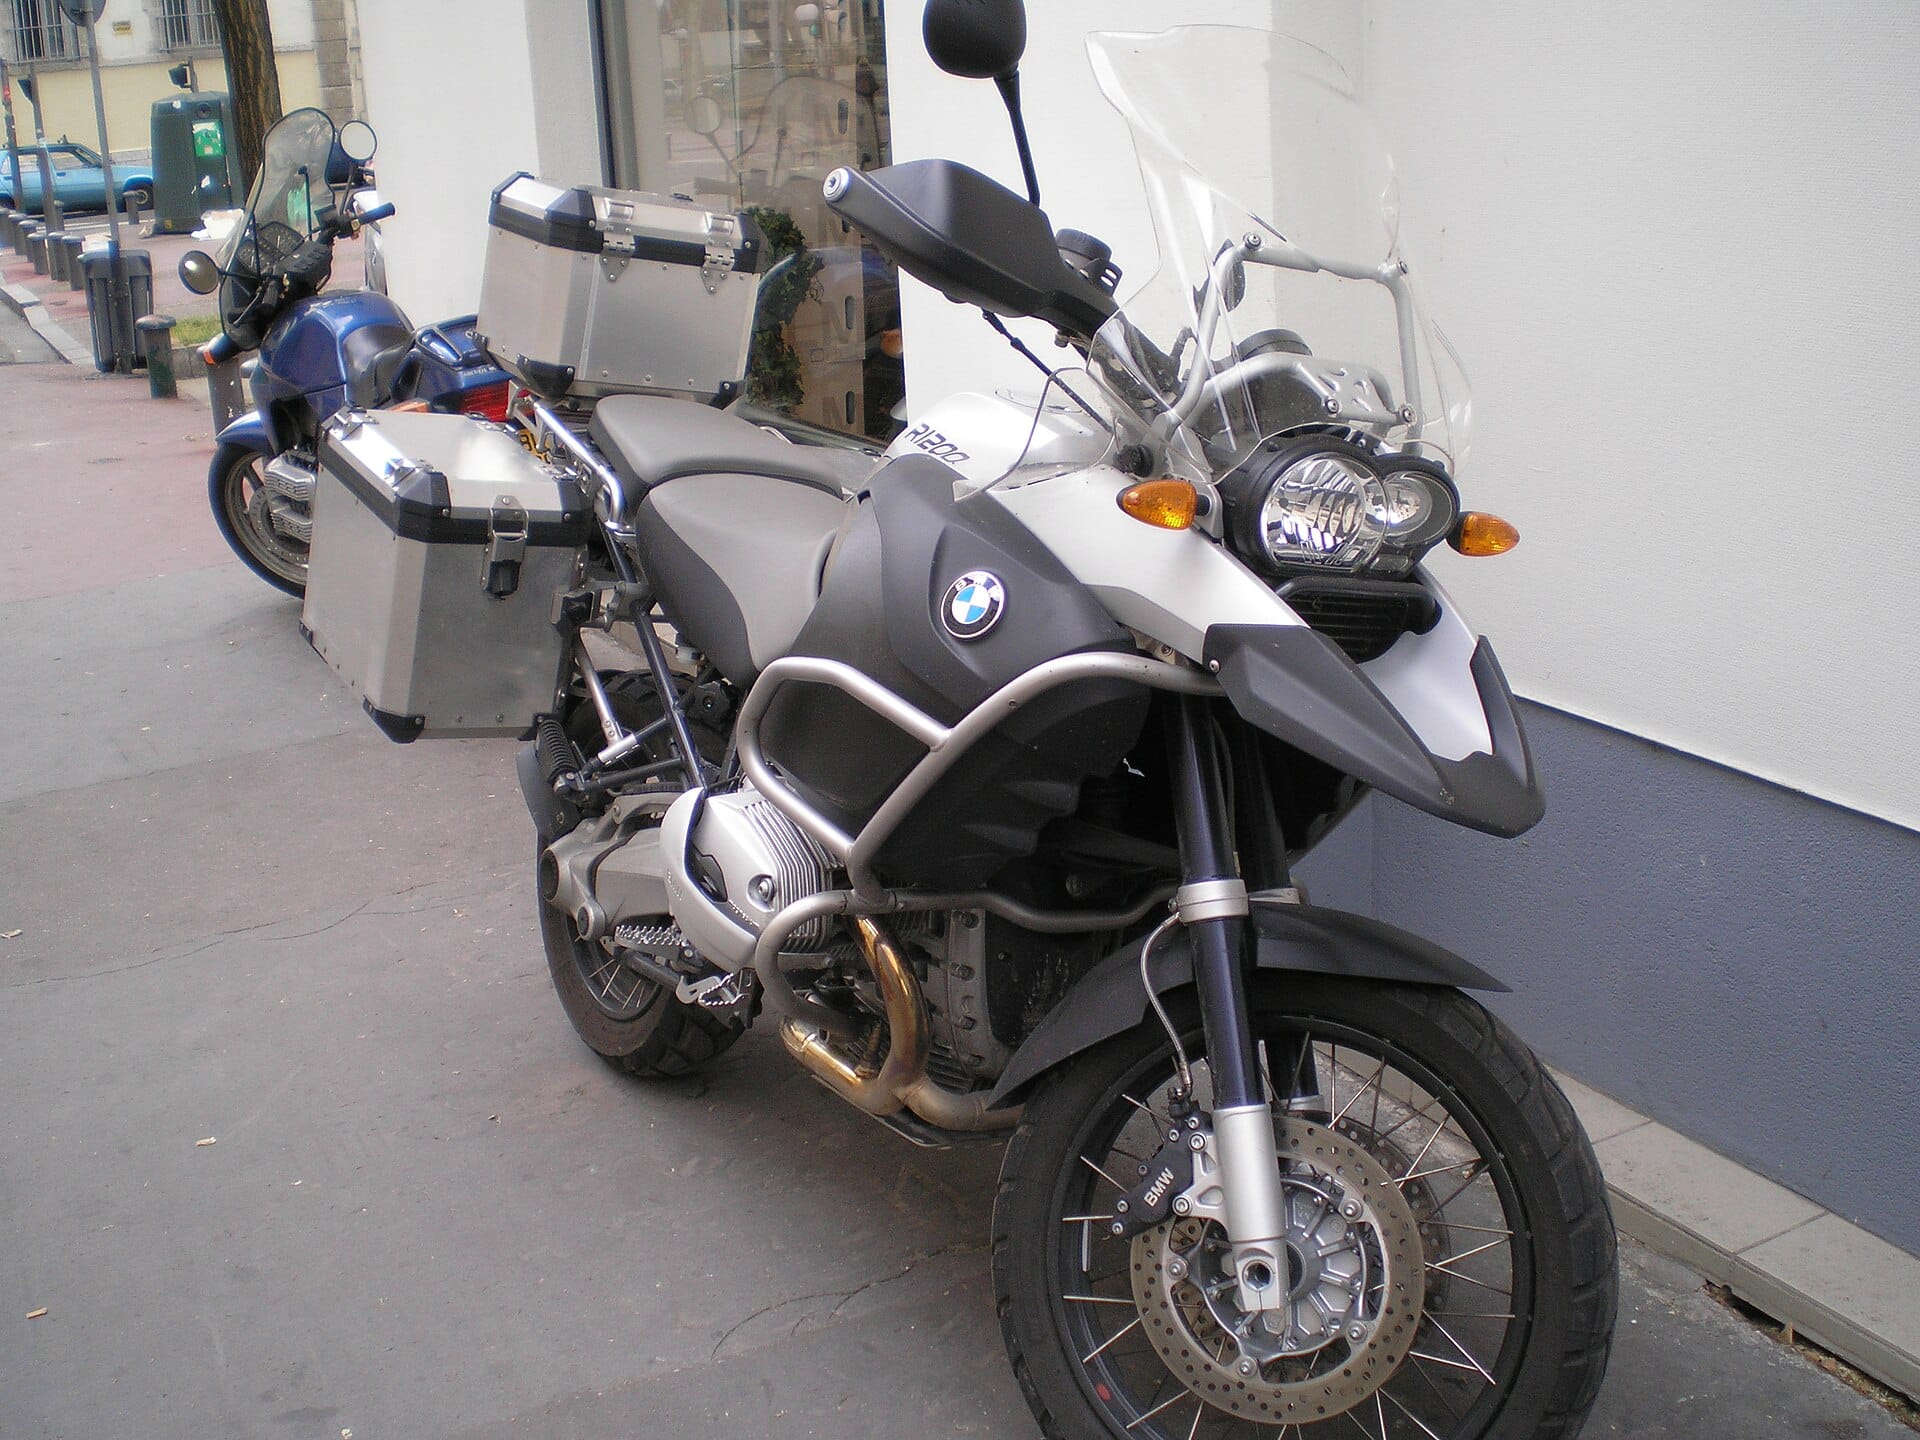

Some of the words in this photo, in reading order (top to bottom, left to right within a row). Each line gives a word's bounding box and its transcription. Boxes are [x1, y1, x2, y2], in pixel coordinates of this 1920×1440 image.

[905, 423, 970, 463] R1200
[954, 572, 1001, 602] BMW
[1143, 1167, 1175, 1207] BMW
